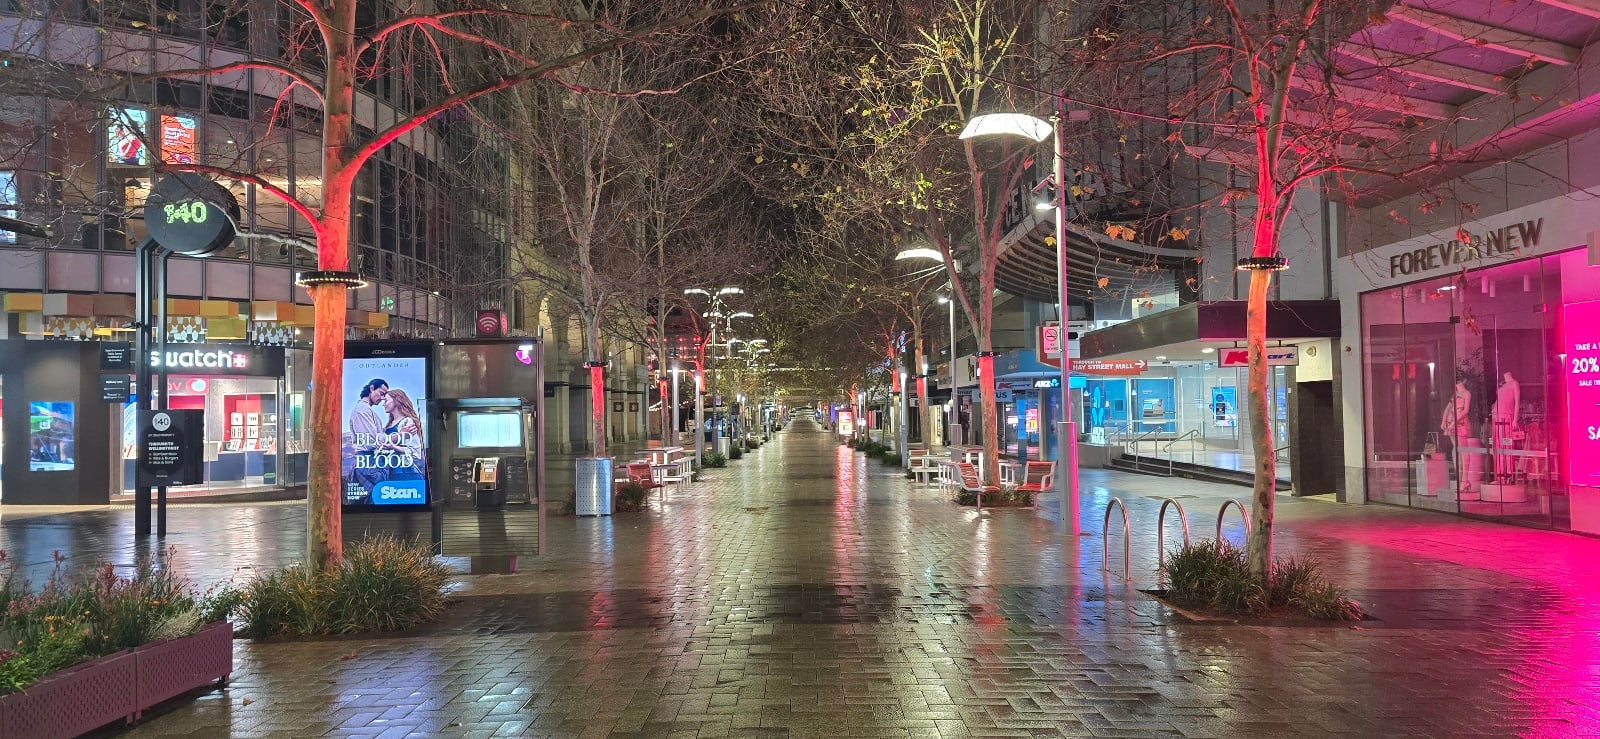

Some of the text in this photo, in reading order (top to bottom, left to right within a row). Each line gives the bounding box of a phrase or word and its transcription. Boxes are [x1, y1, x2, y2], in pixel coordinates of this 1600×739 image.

[164, 201, 207, 225] 140
[1390, 217, 1545, 279] FOREVER NEW
[1575, 342, 1598, 351] TAKE A
[1224, 351, 1295, 365] Kart
[1571, 356, 1600, 374] 20%
[355, 432, 413, 446] BLOOD
[355, 455, 414, 469] BLOOD
[380, 485, 422, 499] Stan.
